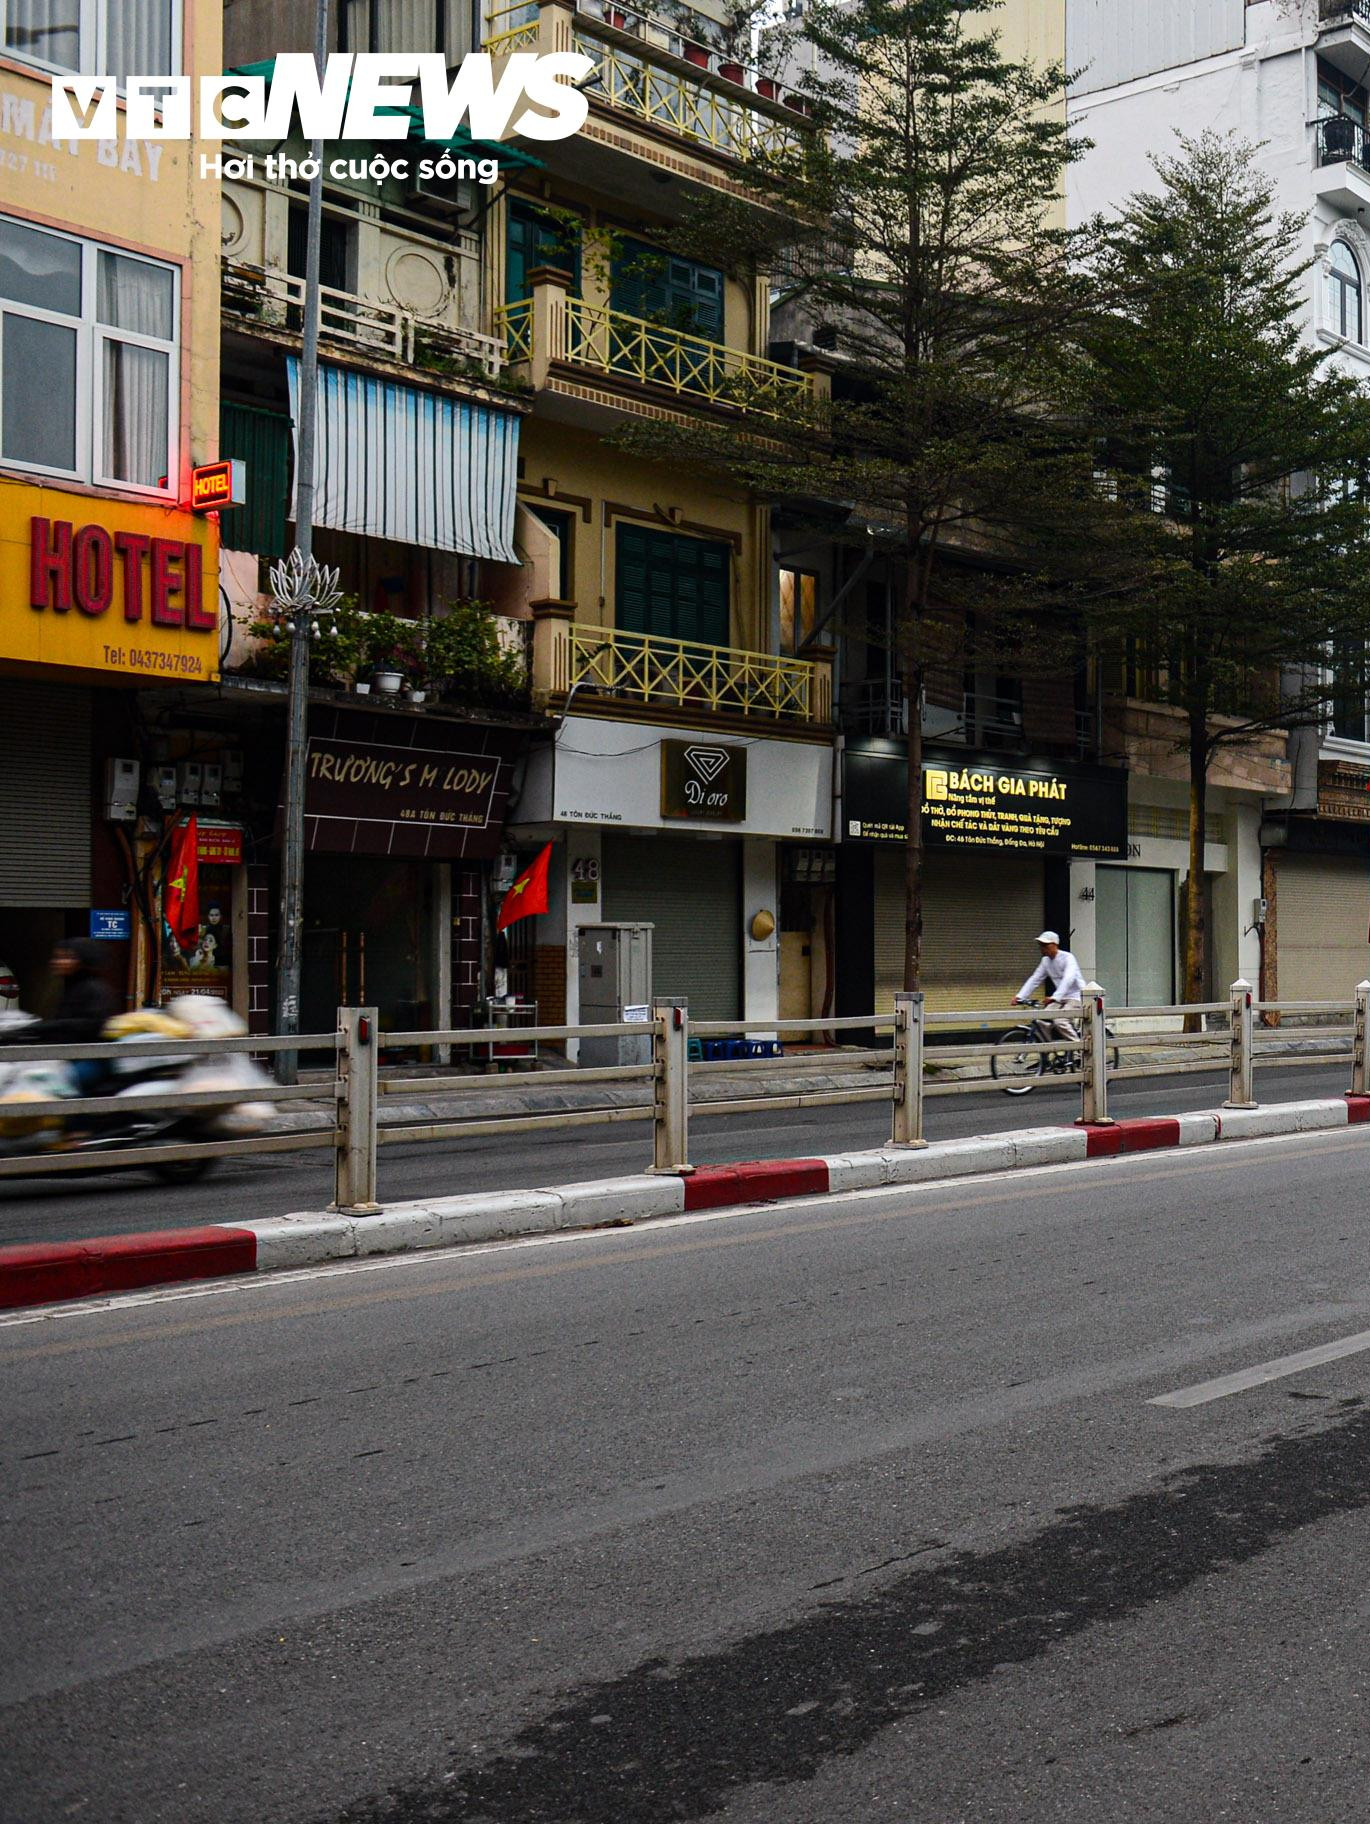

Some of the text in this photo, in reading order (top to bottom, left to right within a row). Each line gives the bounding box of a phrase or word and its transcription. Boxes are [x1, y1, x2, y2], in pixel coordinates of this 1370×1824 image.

[194, 473, 229, 497] HOTEL
[30, 515, 217, 631] HOTEL
[103, 645, 202, 674] Tel: 0437347924
[684, 780, 729, 807] Di oro
[949, 767, 1067, 800] BÁCH GIA PHÁT
[569, 809, 583, 818] TÔN
[573, 858, 599, 881] 48
[1081, 886, 1095, 901] 44
